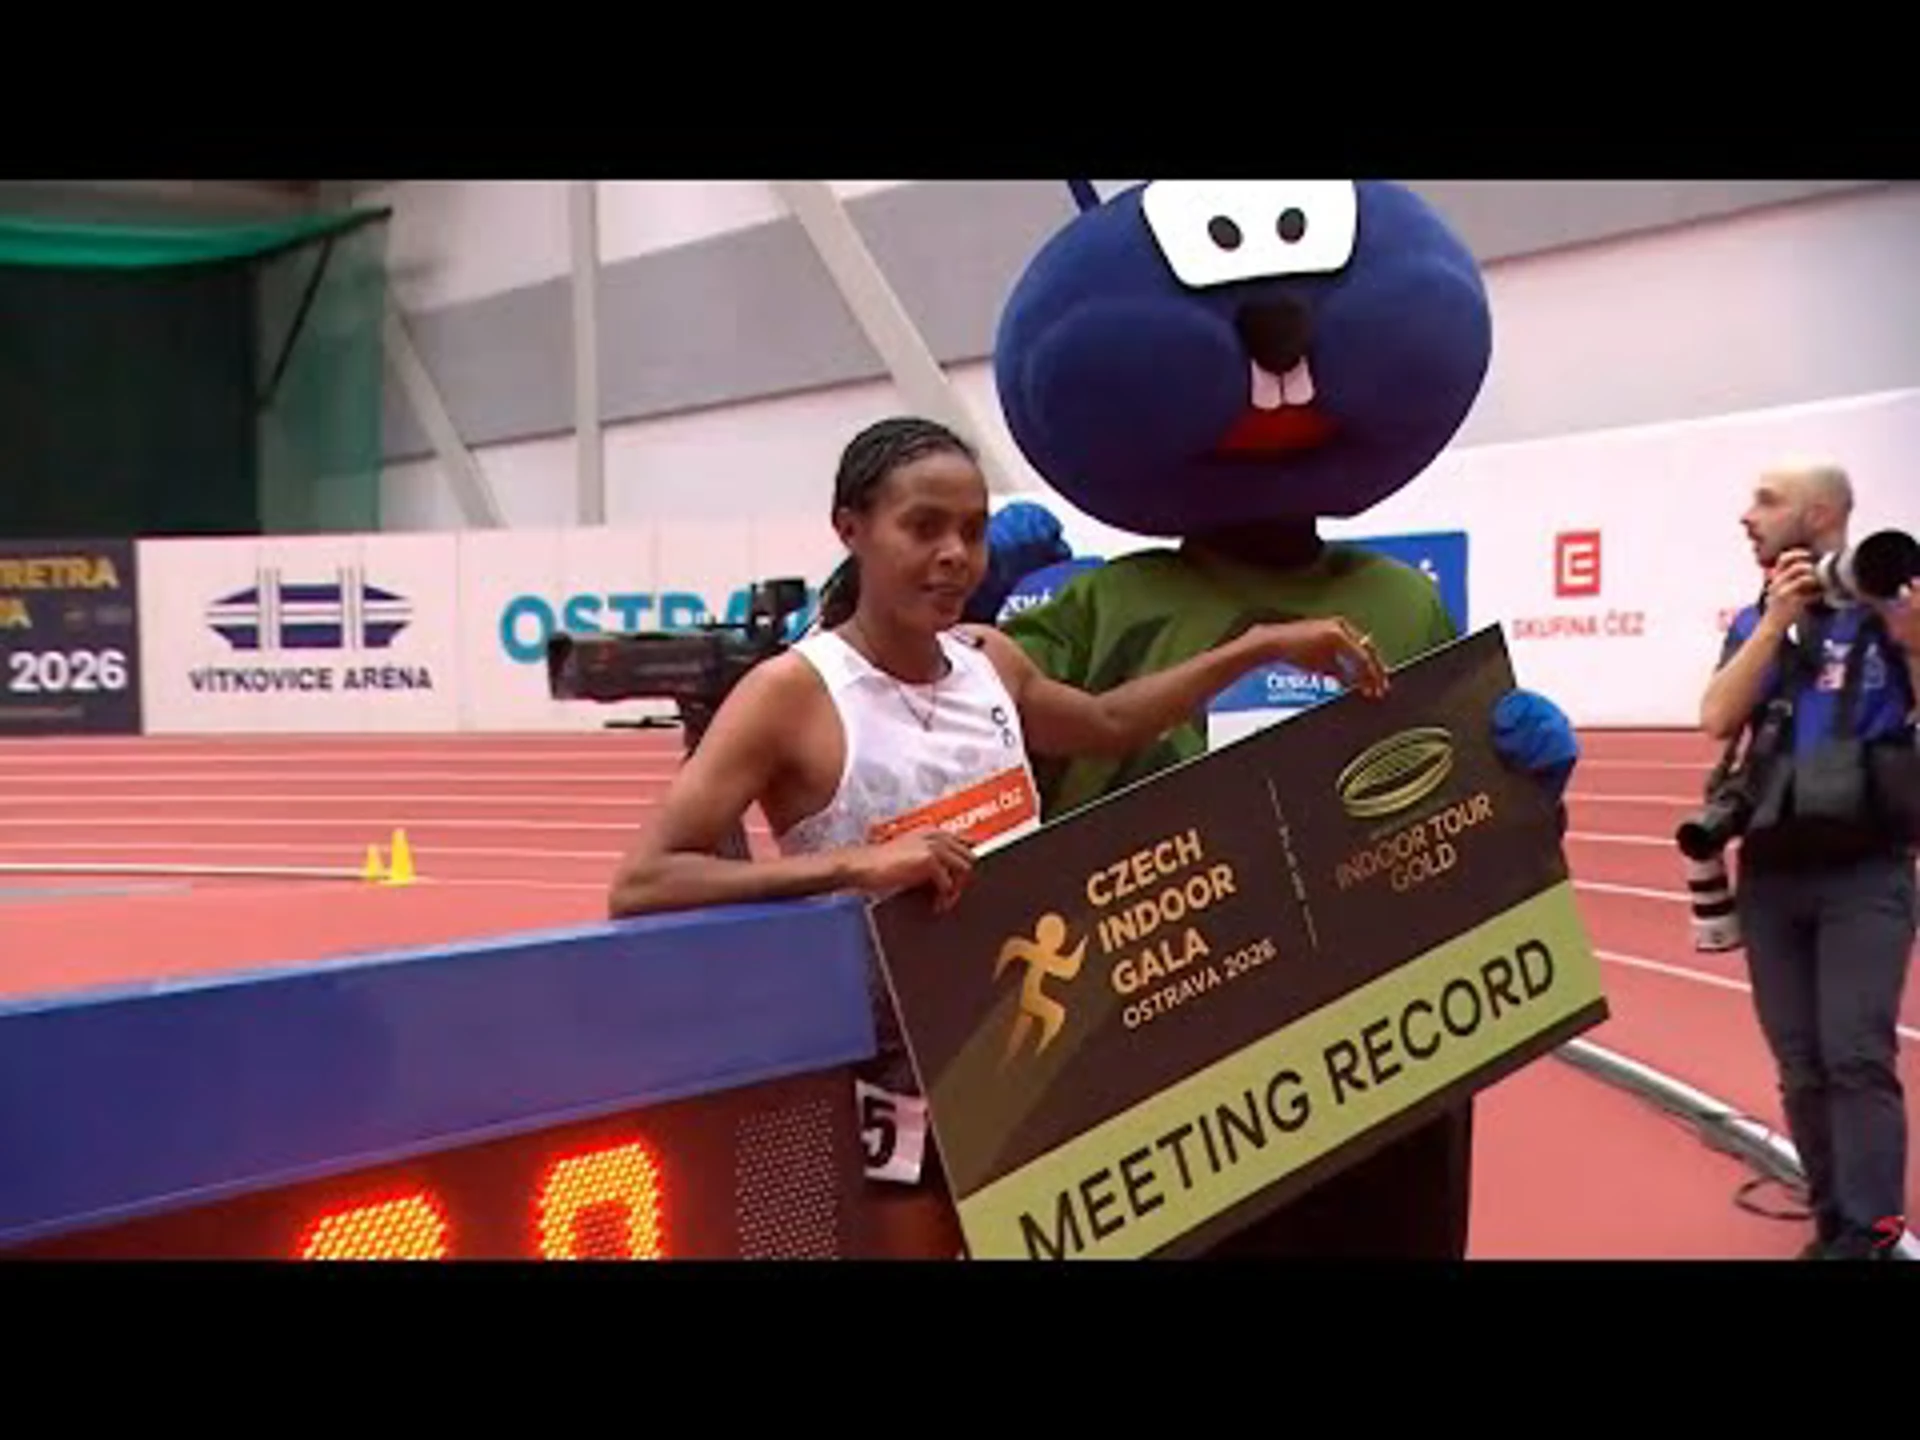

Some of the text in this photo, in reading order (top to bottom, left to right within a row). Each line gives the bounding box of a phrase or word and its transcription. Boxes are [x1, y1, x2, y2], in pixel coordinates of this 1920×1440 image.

[8, 648, 128, 692] 2026
[188, 664, 433, 694] VÍTKOVICE ARÉNA
[1086, 829, 1202, 906] CZECH
[1336, 825, 1430, 892] INDOOR
[1428, 792, 1494, 841] TOUR
[1391, 842, 1458, 893] GOLD
[1098, 864, 1237, 954] INDOOR
[1111, 927, 1210, 997] GALA
[1122, 967, 1222, 1030] OSTRAVA
[862, 1096, 898, 1169] 5
[1018, 938, 1555, 1260] MEETING RECORD
